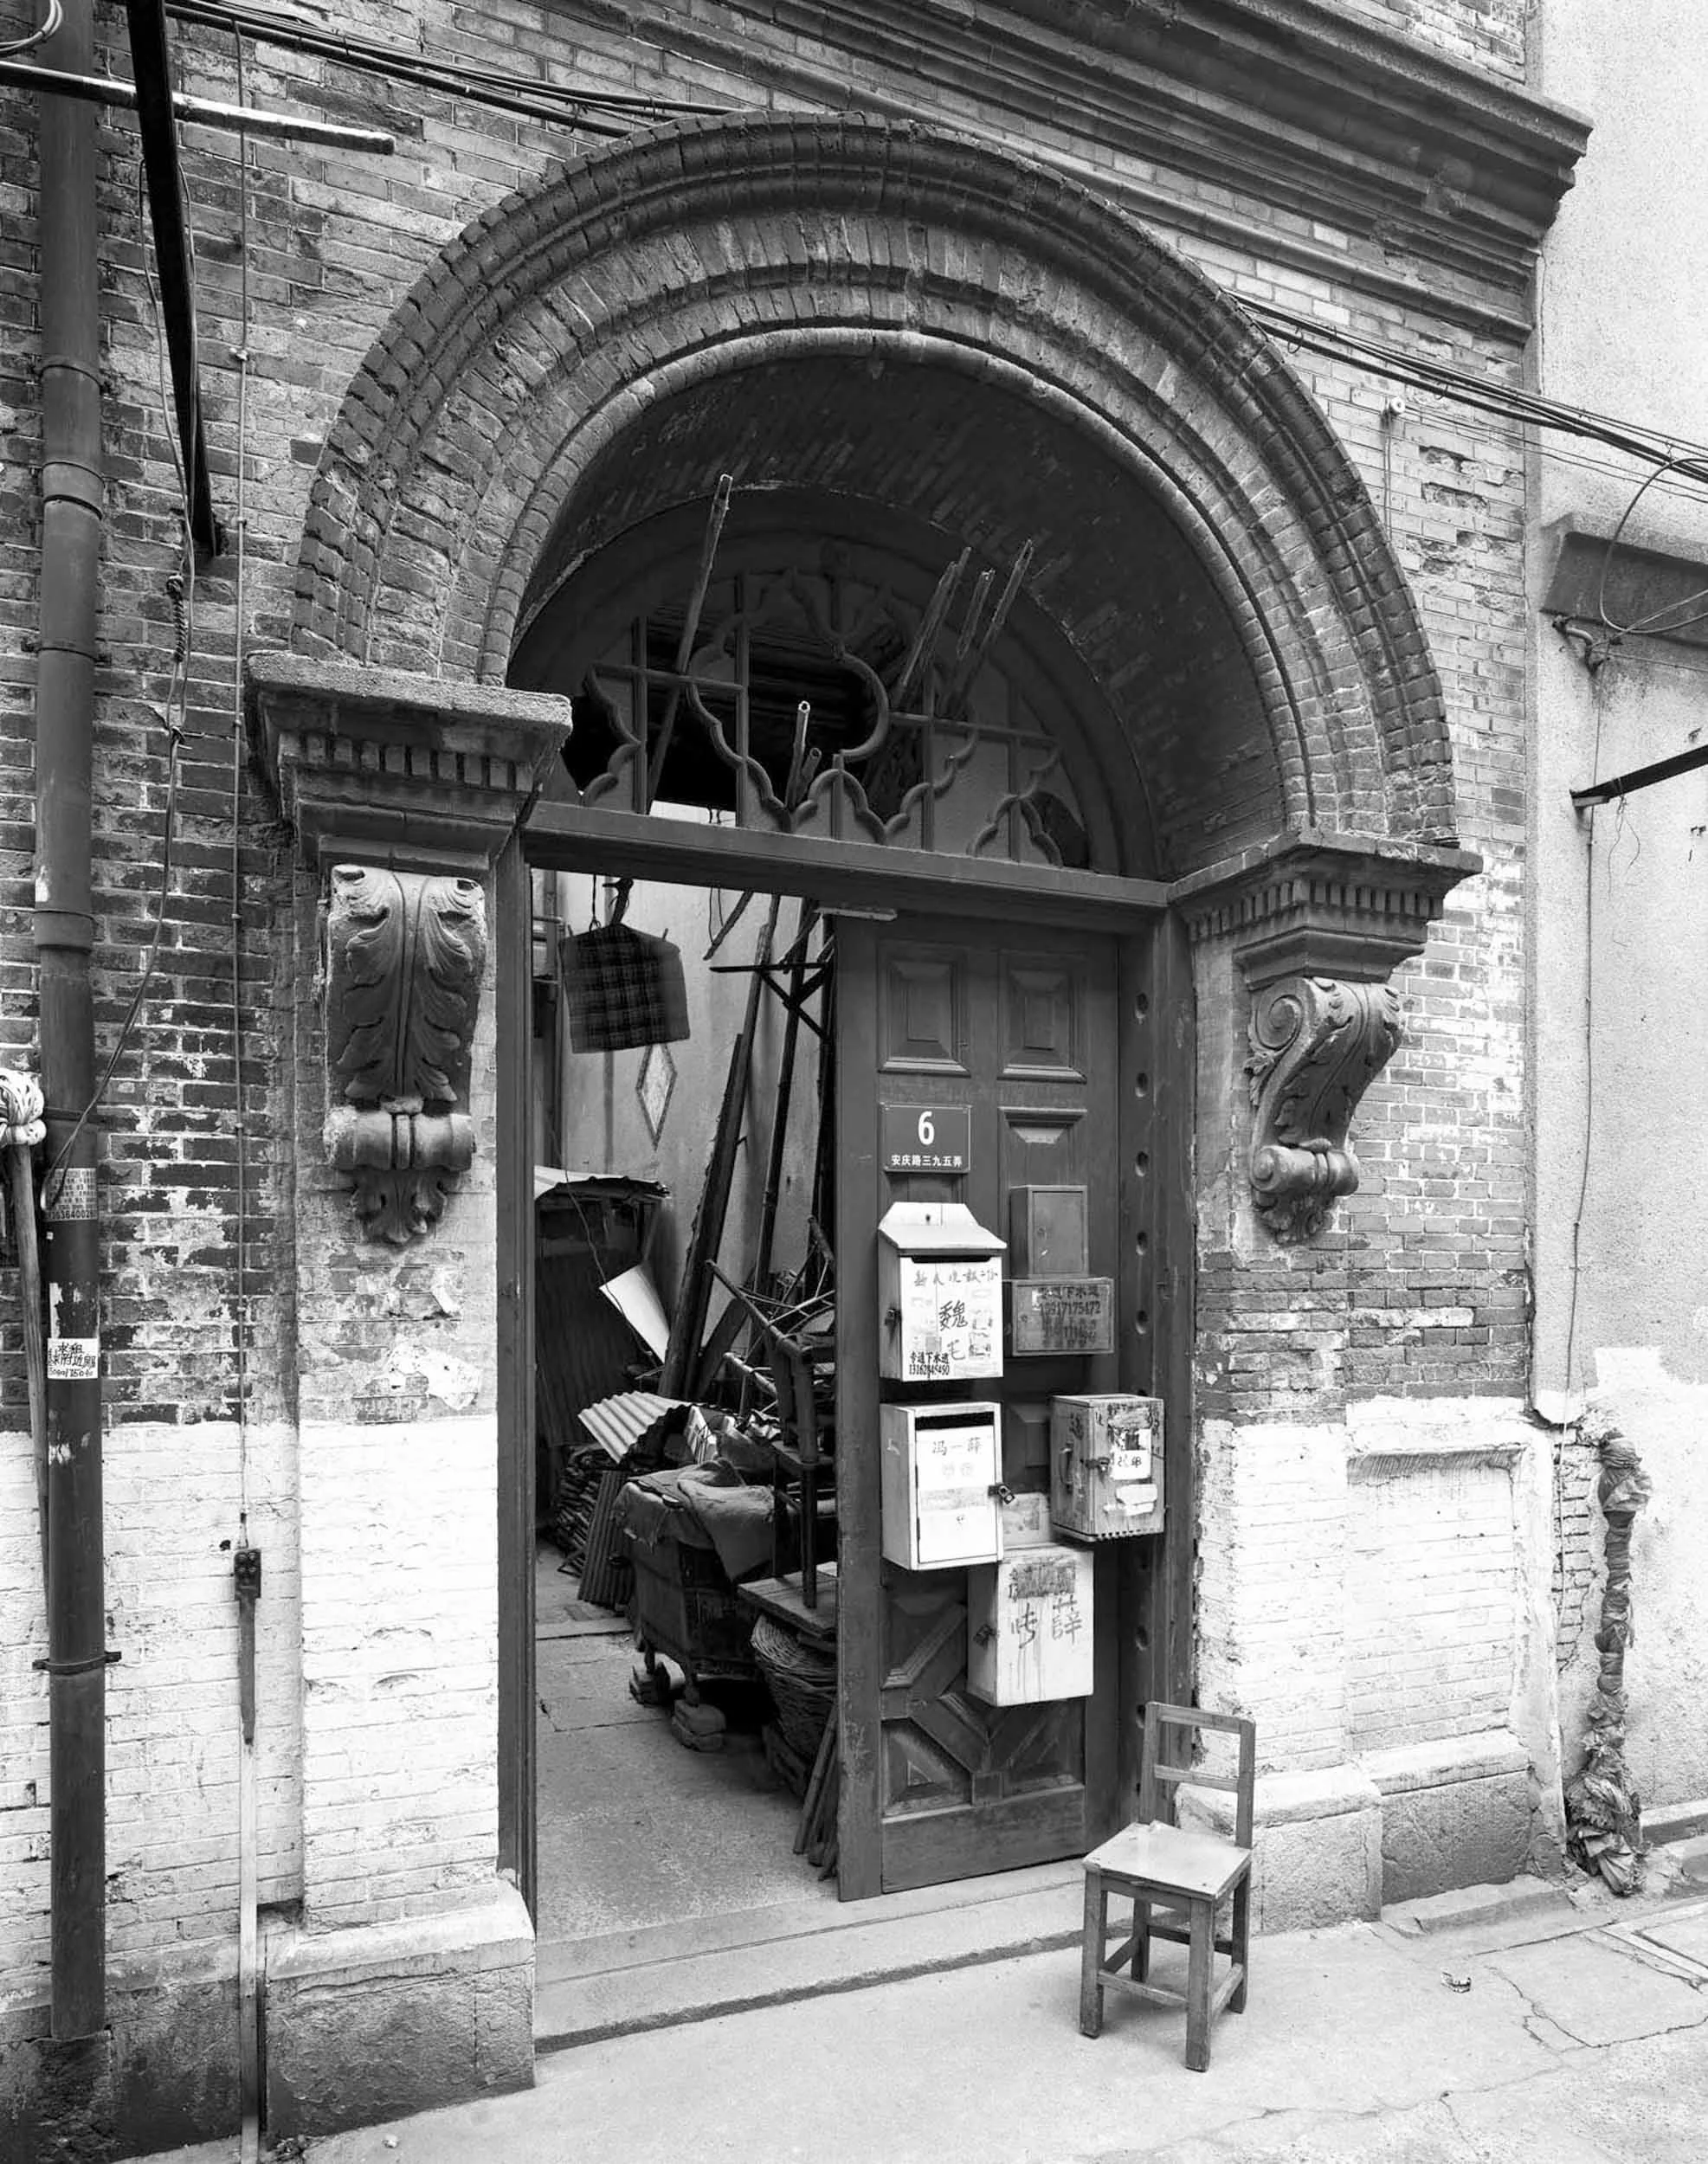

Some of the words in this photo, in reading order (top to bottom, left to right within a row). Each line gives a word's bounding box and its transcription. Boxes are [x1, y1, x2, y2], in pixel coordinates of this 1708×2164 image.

[918, 1111, 935, 1145] 6
[891, 1154, 963, 1168] 安庆路三九五弄
[938, 1299, 968, 1331] 魏
